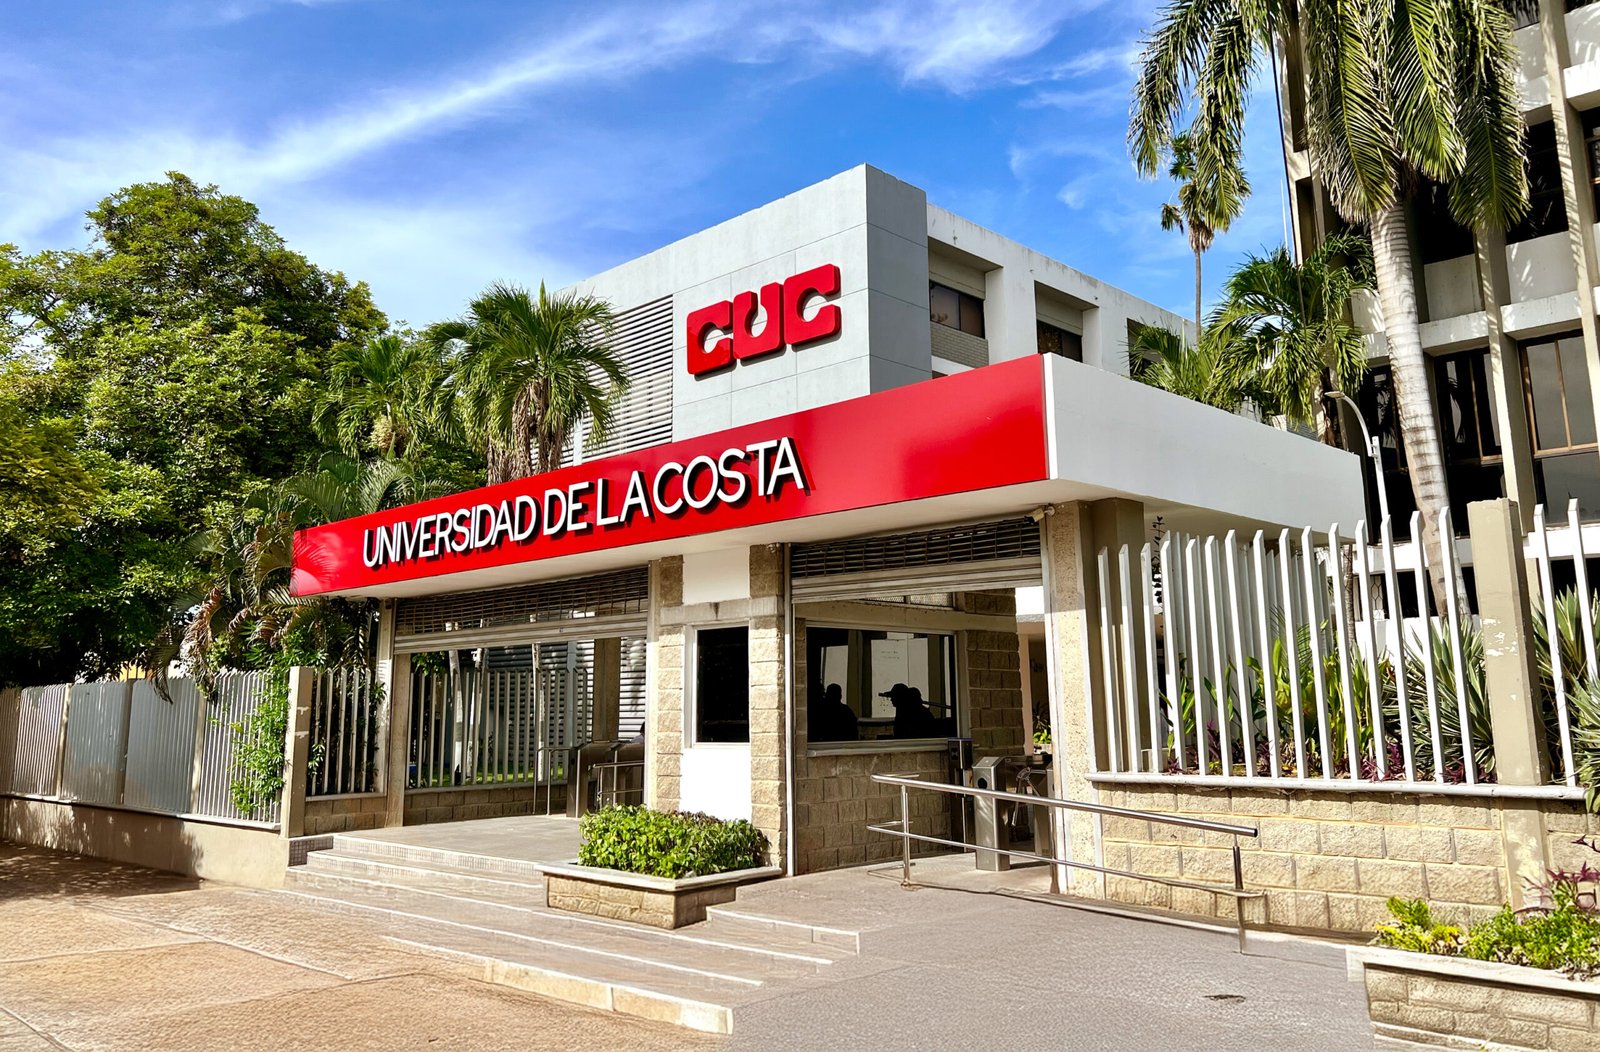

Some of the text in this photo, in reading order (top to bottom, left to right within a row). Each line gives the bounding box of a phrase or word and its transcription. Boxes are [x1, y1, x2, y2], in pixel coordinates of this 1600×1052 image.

[687, 264, 841, 374] CUC
[363, 437, 804, 568] UNIVERSIDAD DE LA COSTA
